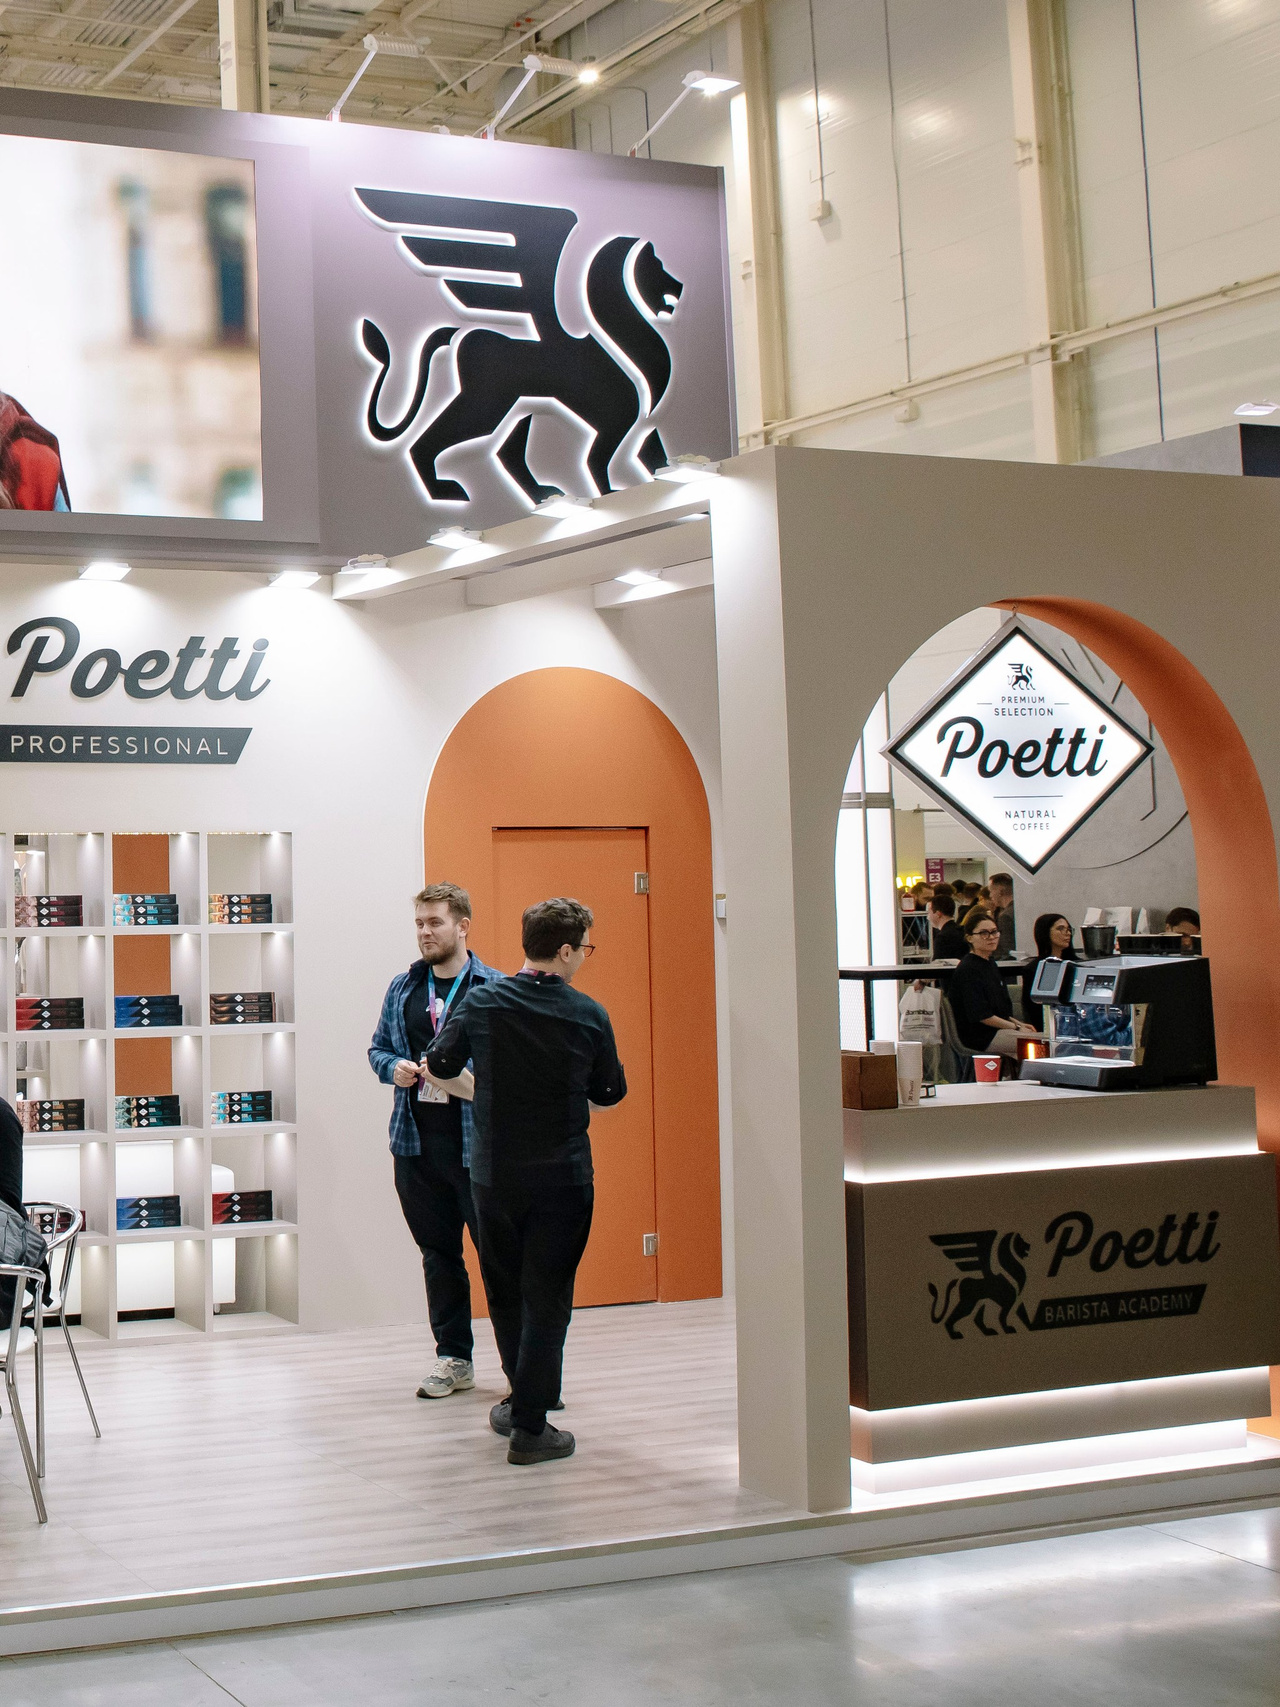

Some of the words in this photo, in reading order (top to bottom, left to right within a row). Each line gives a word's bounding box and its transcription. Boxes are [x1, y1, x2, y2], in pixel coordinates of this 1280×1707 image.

[7, 616, 271, 702] Poetti
[1001, 696, 1045, 704] PREMIUM
[994, 707, 1054, 717] SELECTION
[11, 735, 228, 756] PROFESSIONAL
[936, 716, 1108, 778] Poetti
[1005, 809, 1056, 819] NATURAL
[1012, 823, 1050, 831] COFFEE
[929, 873, 941, 882] E3
[1044, 1210, 1220, 1278] Poetti
[1045, 1301, 1109, 1323] BARISTA
[1119, 1292, 1194, 1315] ACADEMY
